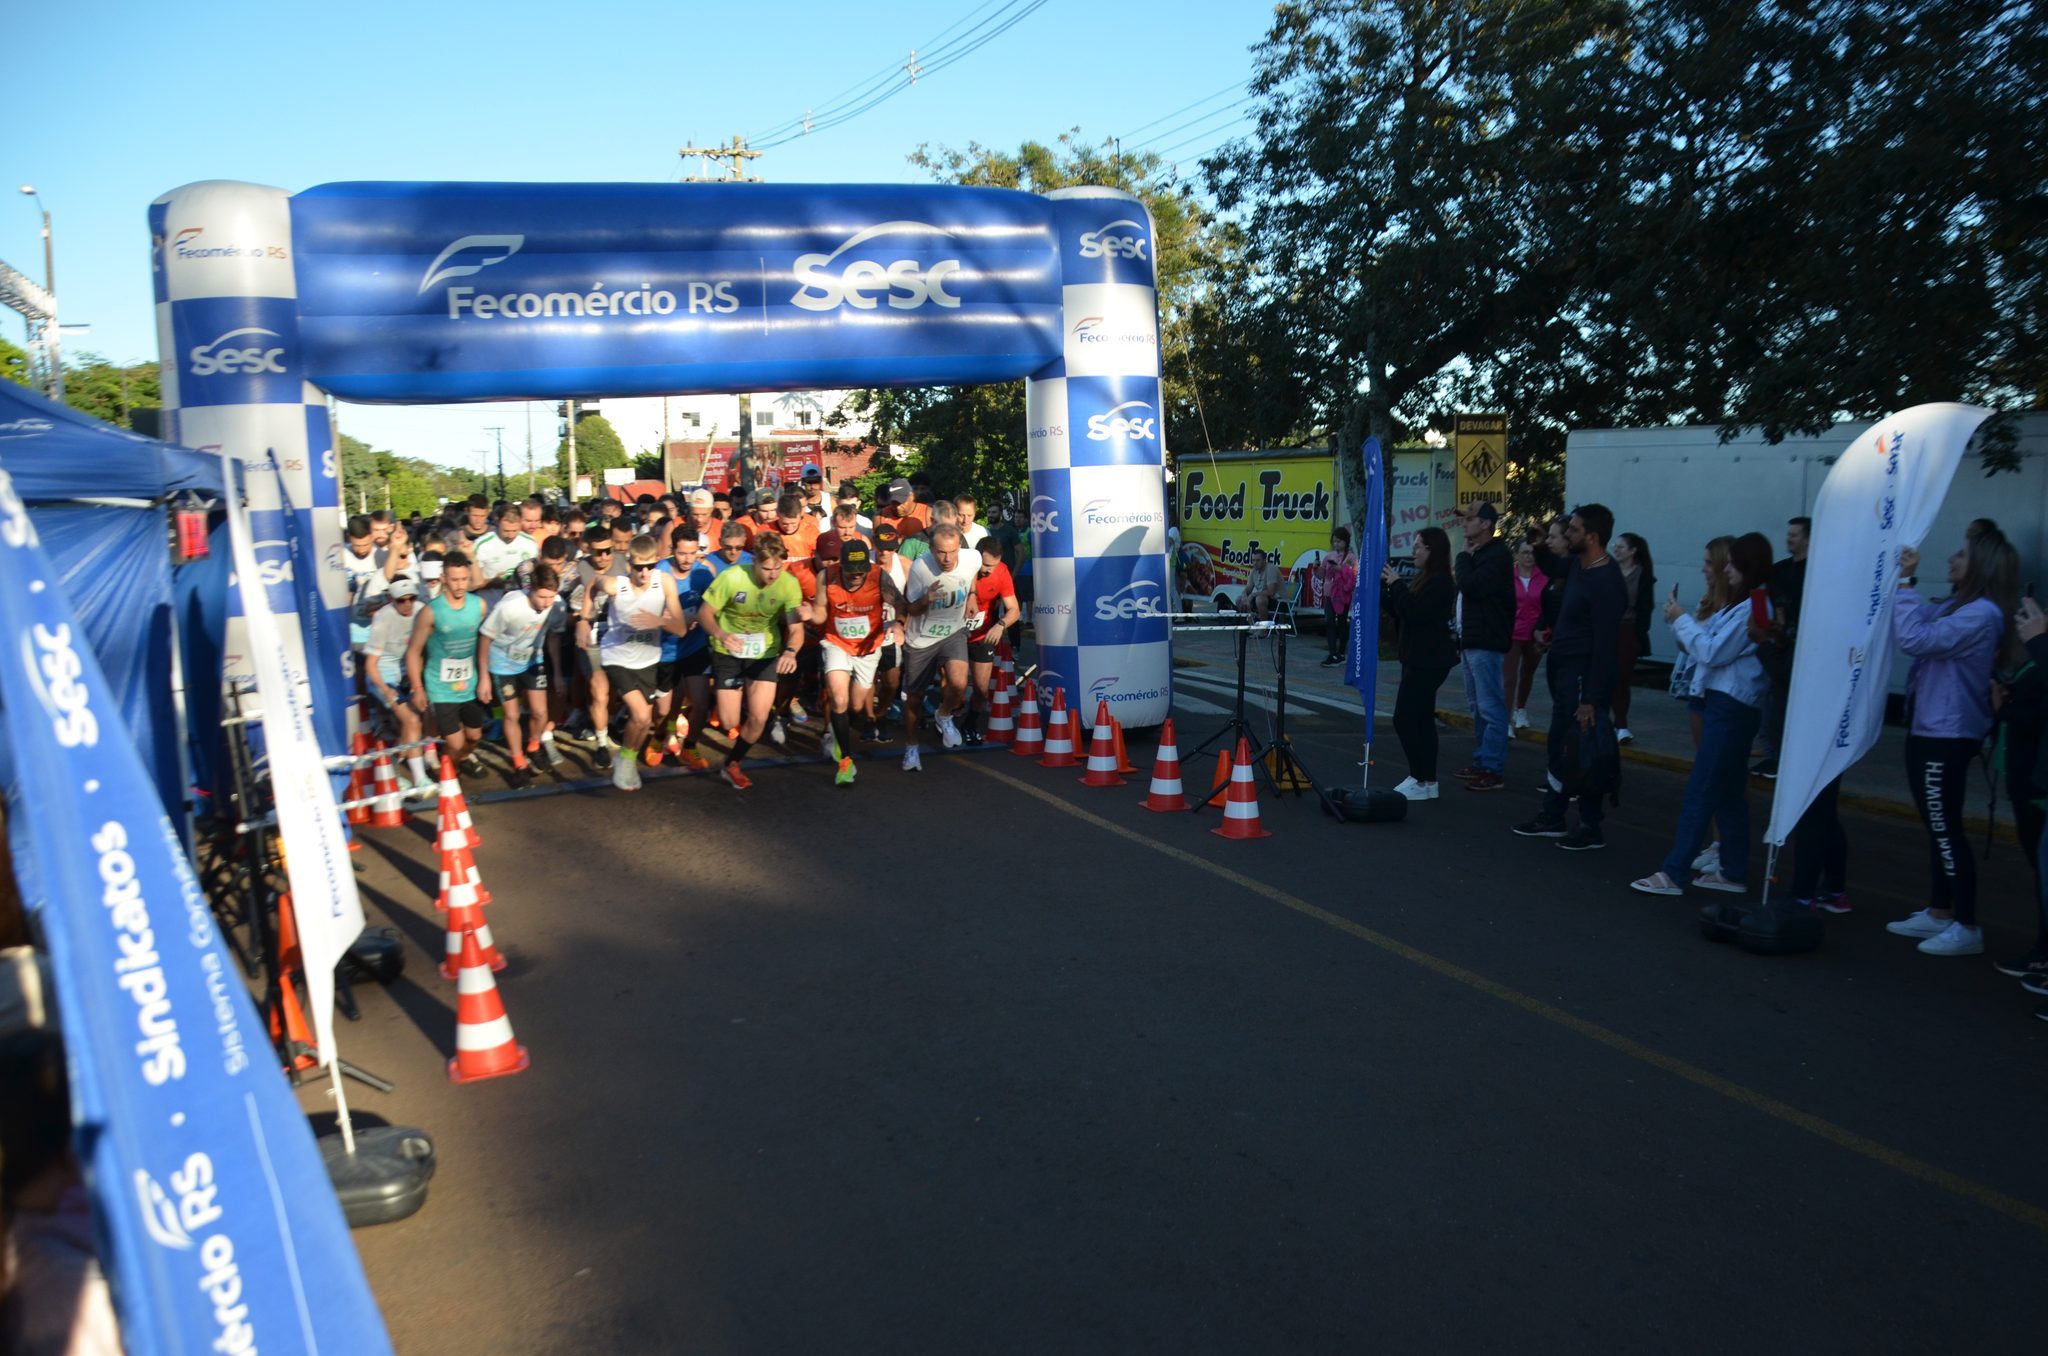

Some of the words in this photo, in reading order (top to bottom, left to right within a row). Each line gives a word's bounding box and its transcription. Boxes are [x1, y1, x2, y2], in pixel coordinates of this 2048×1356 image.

[267, 246, 288, 259] RS
[1079, 231, 1147, 261] Sesc
[790, 250, 961, 312] Sesc
[448, 282, 677, 320] Fecomércio
[688, 281, 740, 314] RS
[190, 344, 287, 376] Sesc
[1049, 426, 1064, 437] RS
[1087, 413, 1155, 441] Sesc
[1459, 419, 1503, 432] DEVAGAR
[285, 460, 304, 471] RS
[1392, 466, 1429, 486] ruck
[1184, 470, 1246, 521] Food
[1258, 469, 1330, 522] Truck
[1460, 491, 1503, 504] ELEVADA
[1031, 511, 1059, 532] esc
[1088, 513, 1152, 525] Fecomércio
[1154, 513, 1163, 523] RS
[1221, 539, 1281, 566] FoodTck
[1057, 604, 1072, 615] RS
[1094, 595, 1161, 621] Sesc
[841, 625, 866, 637] 494
[928, 624, 952, 636] 423
[739, 642, 761, 656] 79
[446, 667, 469, 680] 781
[30, 622, 98, 748] Sesc
[1096, 690, 1159, 703] Fecomércio
[1160, 686, 1168, 697] RS
[1923, 761, 1947, 832] GROWTH
[91, 821, 187, 1086] Sindicatos
[200, 952, 249, 1077] Sistema
[171, 1151, 224, 1232] RS
